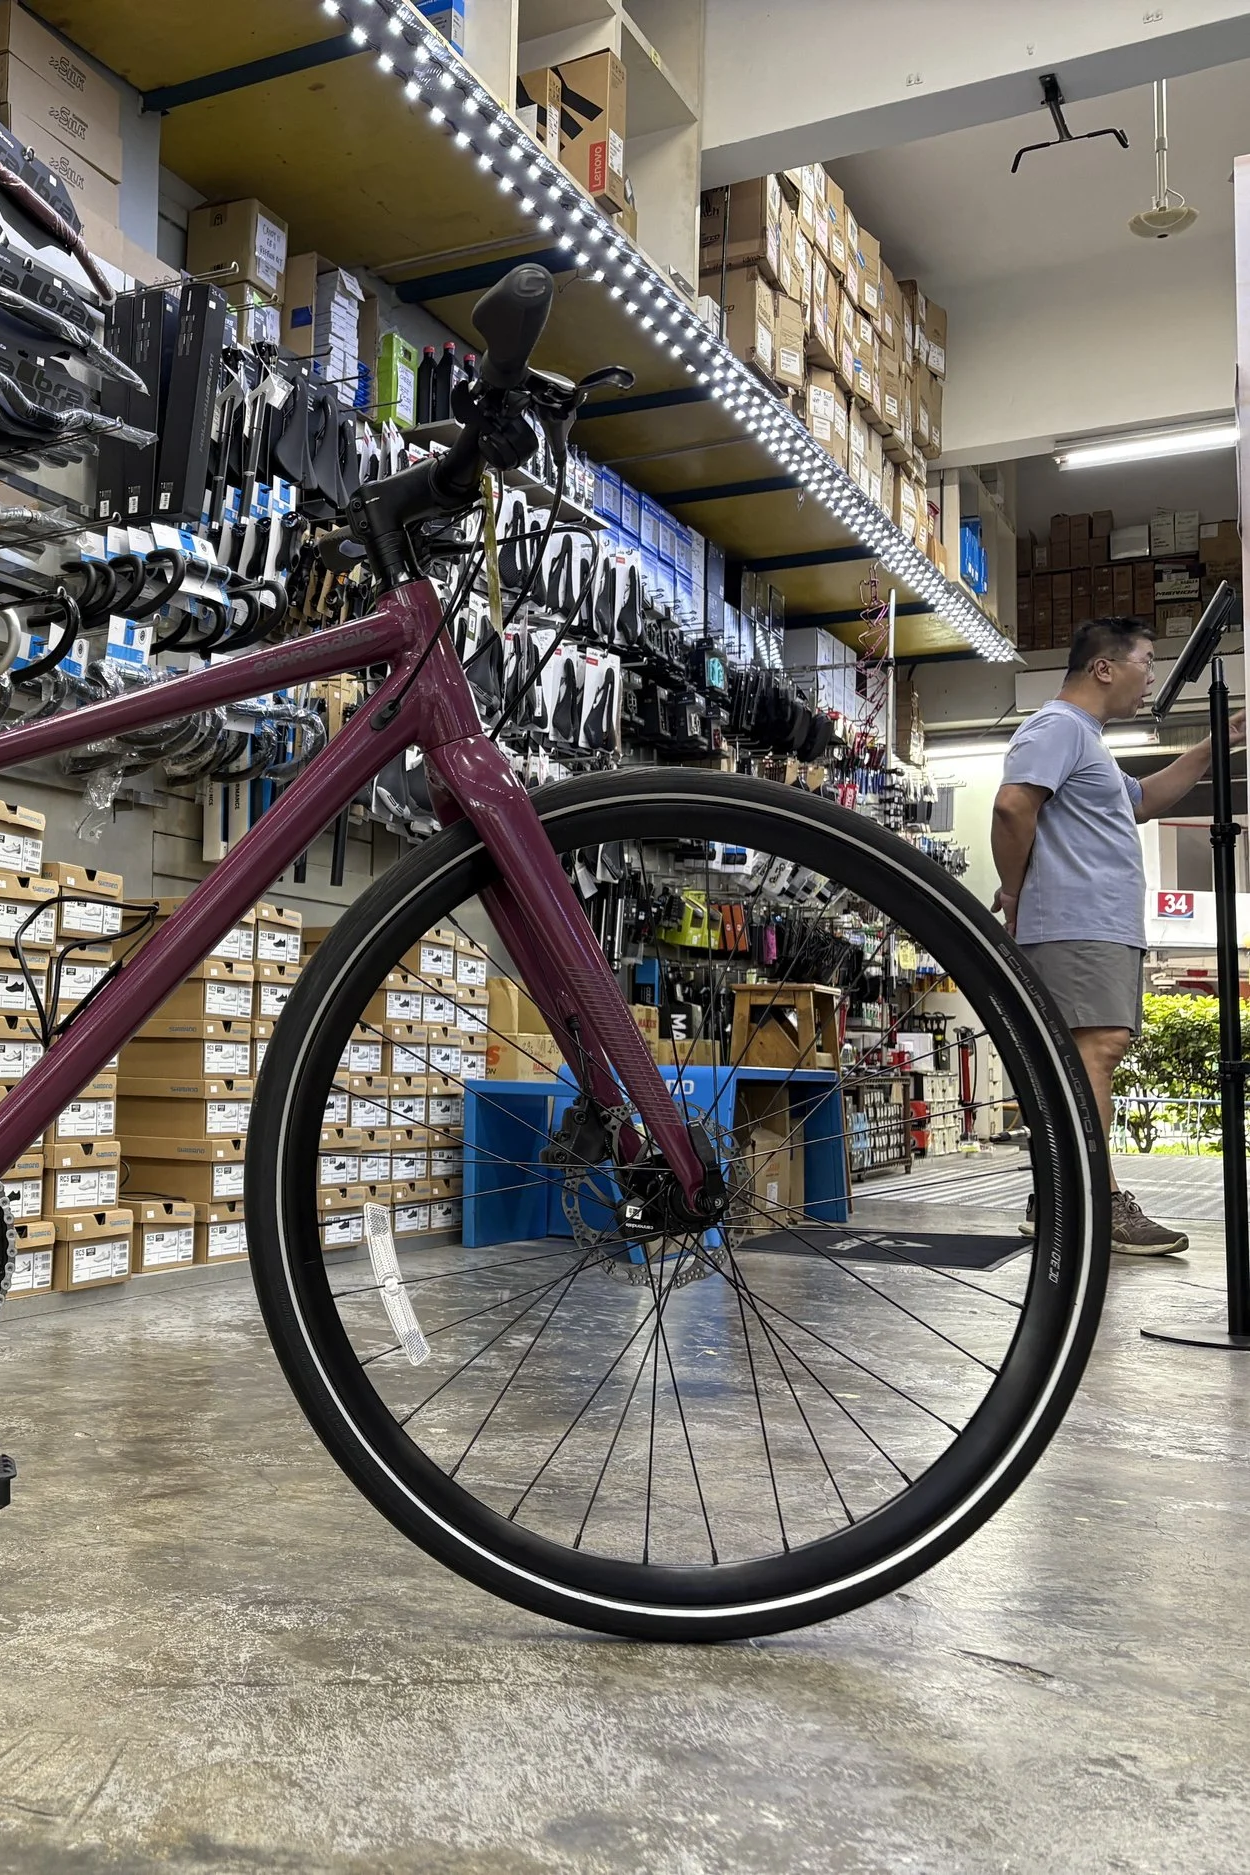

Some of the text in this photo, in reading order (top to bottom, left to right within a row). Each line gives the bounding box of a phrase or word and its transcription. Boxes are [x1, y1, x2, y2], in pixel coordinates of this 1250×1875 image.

[592, 146, 603, 188] Lenovo
[253, 628, 377, 674] cannondale
[1164, 895, 1187, 914] 34
[997, 943, 1065, 1046] SCHWALBE
[1063, 1054, 1094, 1133] LUGANO
